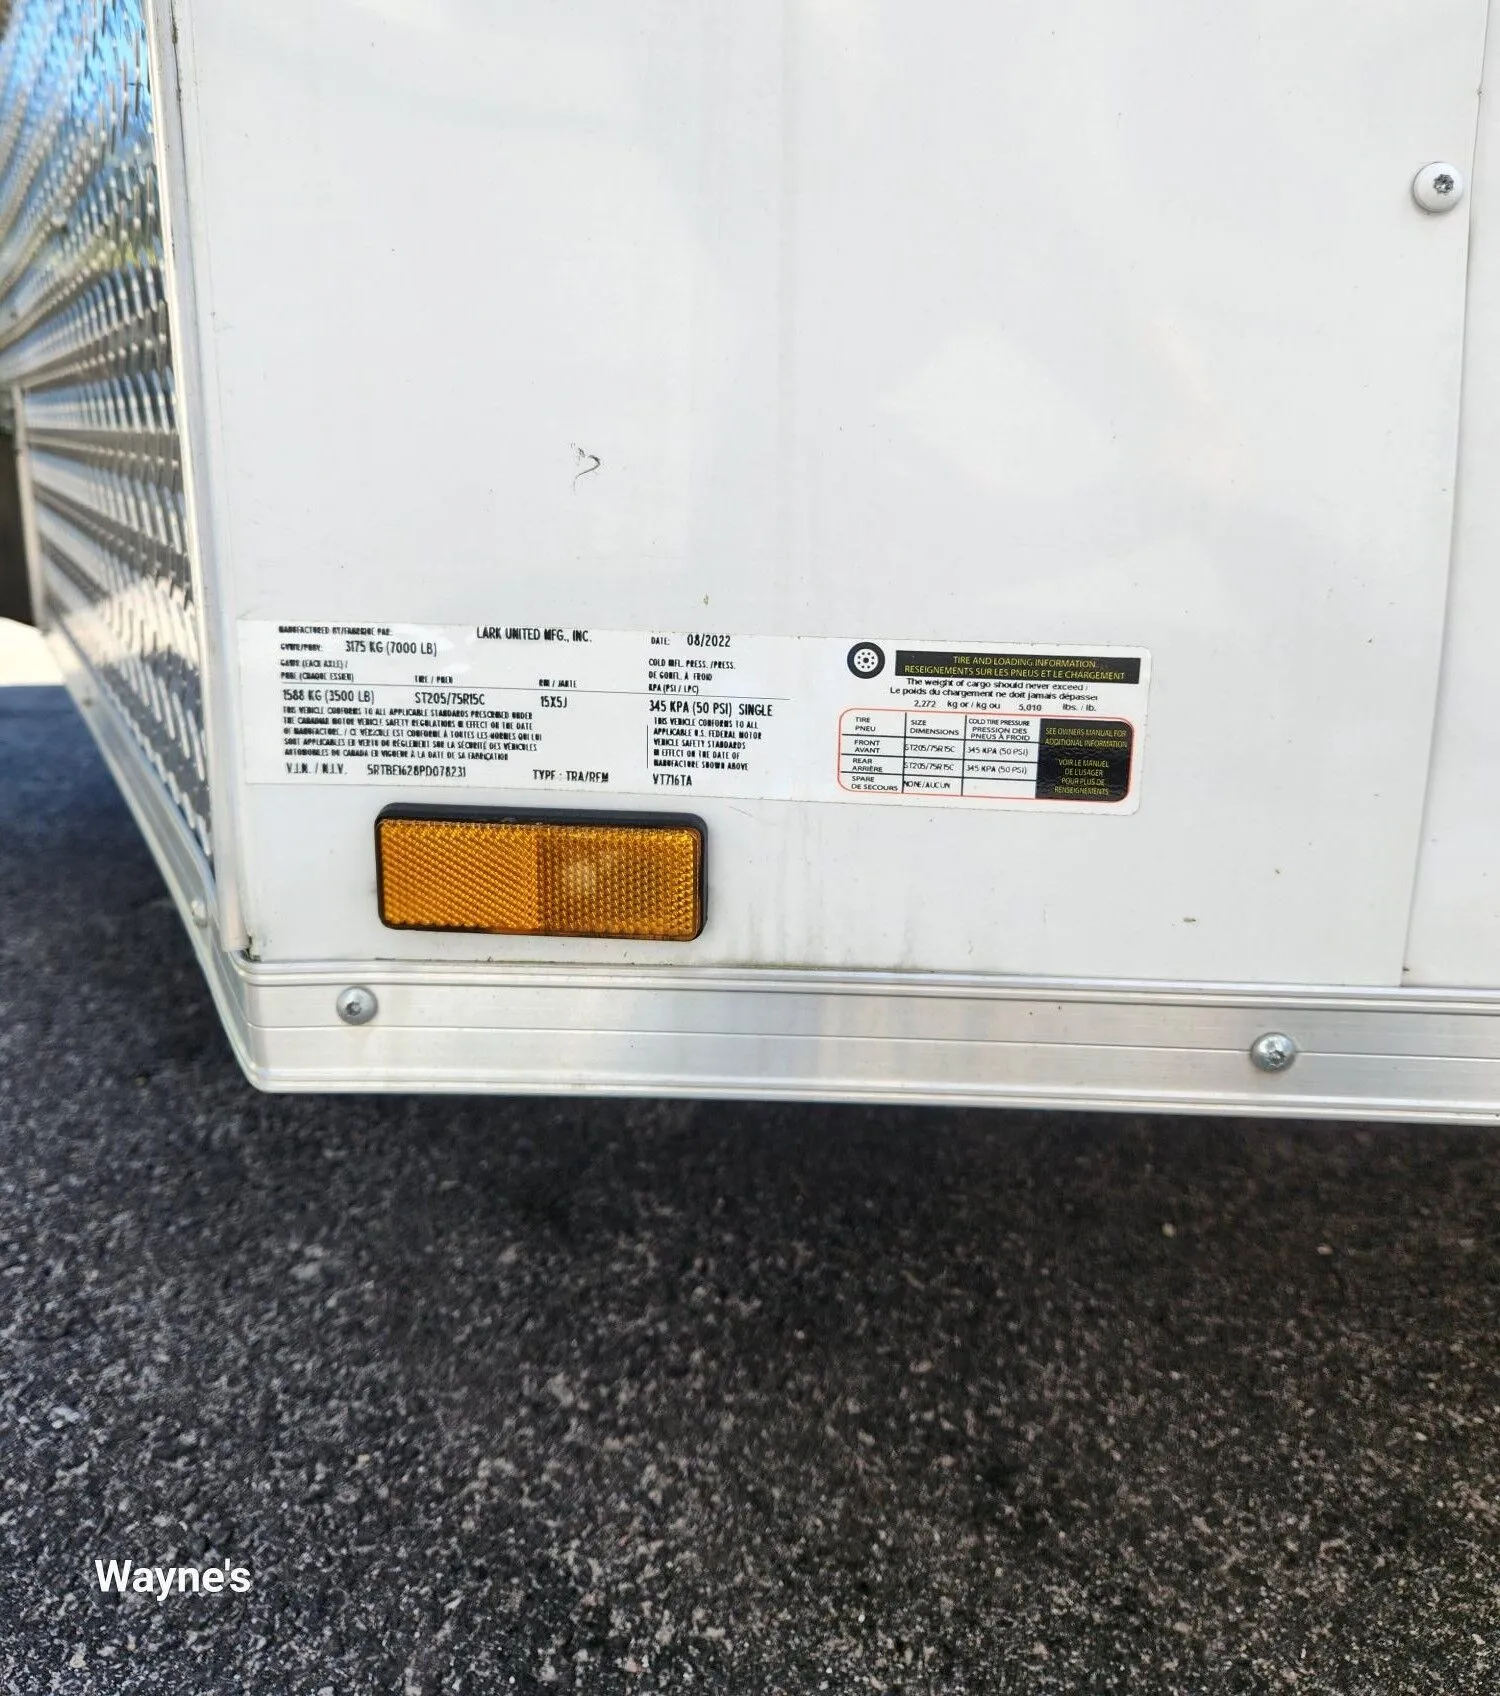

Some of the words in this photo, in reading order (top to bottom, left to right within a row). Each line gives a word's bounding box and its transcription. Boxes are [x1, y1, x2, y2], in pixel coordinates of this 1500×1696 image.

[476, 626, 501, 639] LARK
[505, 627, 540, 640] UNITED
[572, 630, 592, 642] INC.
[686, 634, 730, 647] 08/2022
[345, 639, 366, 652] 3175
[369, 640, 383, 653] KG
[386, 641, 416, 656] (7000
[420, 642, 436, 656] LB)
[953, 656, 970, 664] TIRE
[972, 656, 992, 664] AND
[993, 657, 1034, 666] LOADING
[1035, 660, 1096, 668] INFORMATION
[904, 665, 973, 676] RESEIGNEMENTS
[975, 667, 992, 675] SUR
[994, 668, 1008, 676] LES
[1010, 669, 1039, 677] PNEUS
[1040, 669, 1051, 677] ET
[1052, 670, 1063, 678] LE
[1064, 670, 1124, 680] CHARGEMENT
[925, 678, 952, 687] weight
[282, 688, 304, 701] 1588
[307, 689, 322, 701] KG
[324, 689, 354, 704] (3500
[358, 690, 374, 704] LB)
[414, 691, 485, 706] ST205/75R15C
[902, 687, 927, 696] poids
[942, 688, 992, 697] chargement
[1027, 692, 1057, 701] jamais
[540, 695, 567, 708] 15X5J
[914, 699, 936, 708] 2,272
[946, 700, 958, 709] kg
[976, 701, 987, 710] kg
[1018, 703, 1041, 711] 5,010
[649, 699, 666, 712] 345
[669, 700, 689, 712] KPA
[692, 701, 709, 716] (50
[712, 702, 732, 717] PSI)
[738, 703, 772, 716] SINGLE
[972, 726, 1010, 734] PRESSION
[854, 746, 880, 755] AVANT
[904, 744, 954, 752] ST205/75R15C
[998, 747, 1011, 755] (50
[1012, 748, 1028, 756] PSI)
[997, 765, 1010, 774] (50
[1011, 766, 1027, 774] PSI)
[652, 773, 692, 786] VT716TA
